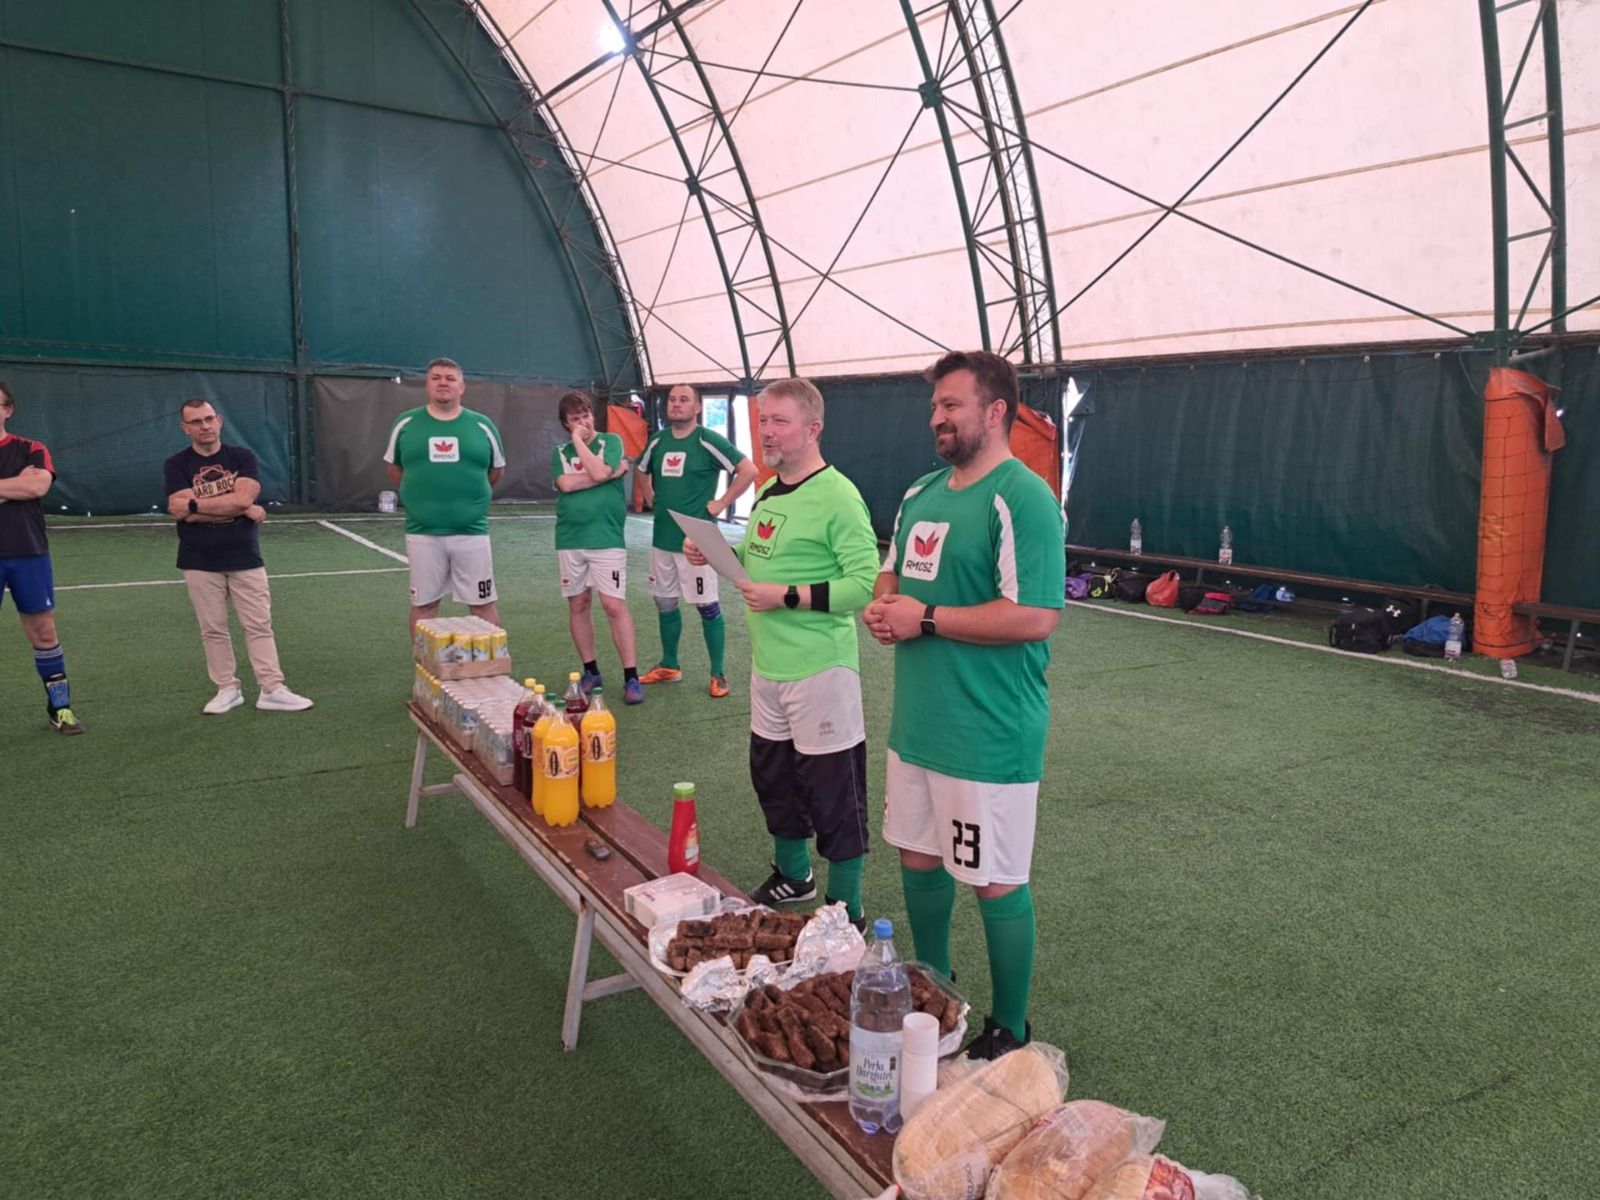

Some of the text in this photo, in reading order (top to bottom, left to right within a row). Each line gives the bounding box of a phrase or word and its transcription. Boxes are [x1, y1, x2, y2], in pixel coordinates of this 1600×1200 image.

[216, 477, 234, 492] ROC
[905, 559, 933, 573] RMDSZ
[478, 579, 491, 599] 99
[612, 570, 620, 589] 4
[696, 576, 704, 595] 8
[952, 819, 981, 869] 23
